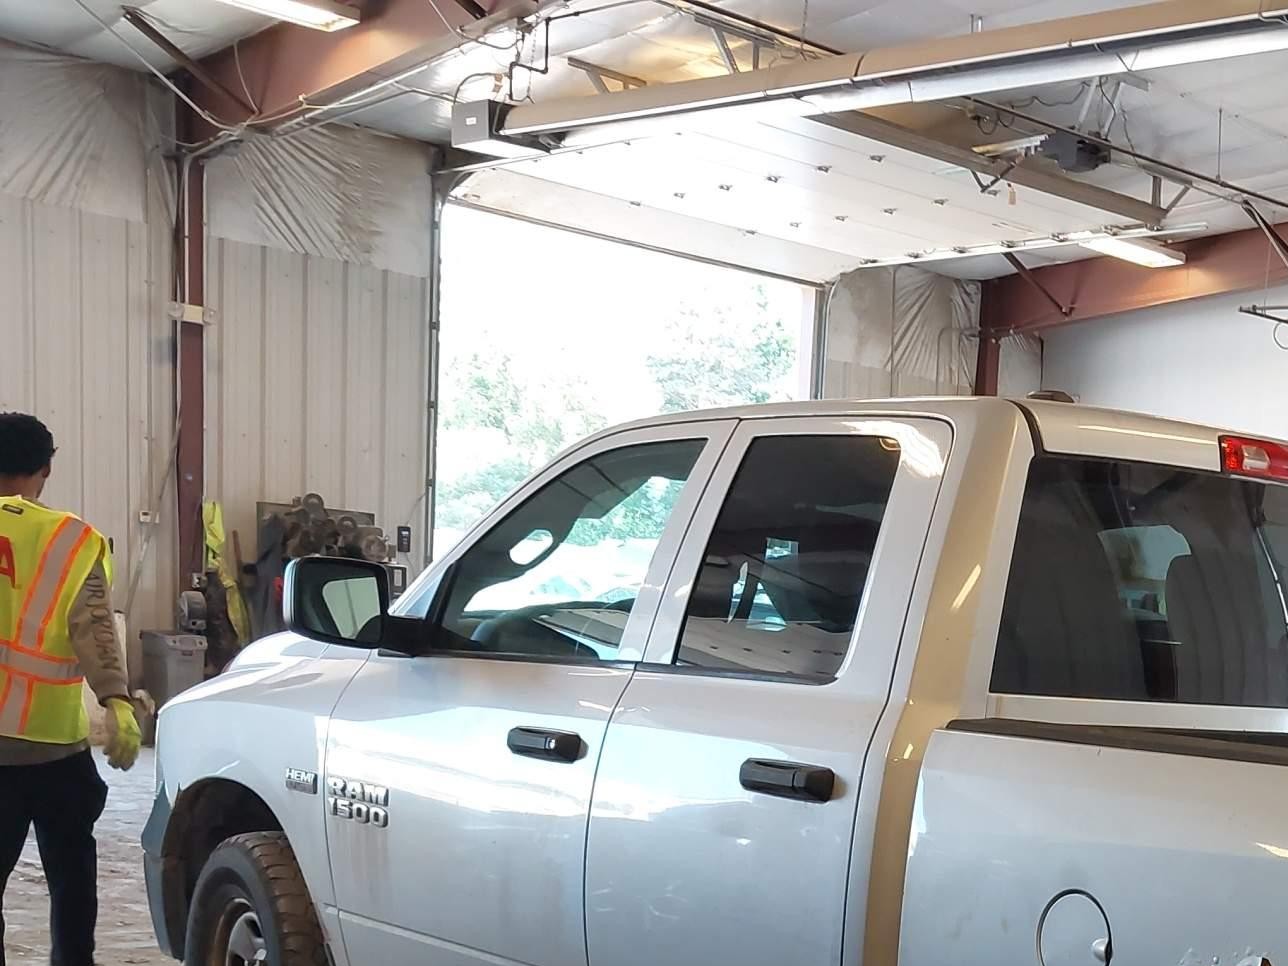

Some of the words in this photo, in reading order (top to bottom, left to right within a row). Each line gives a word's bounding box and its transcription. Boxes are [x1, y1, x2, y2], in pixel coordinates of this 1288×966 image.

[86, 603, 121, 672] JORDAN
[286, 768, 315, 784] HEMI
[328, 776, 389, 807] RAM
[328, 797, 389, 828] 1500
